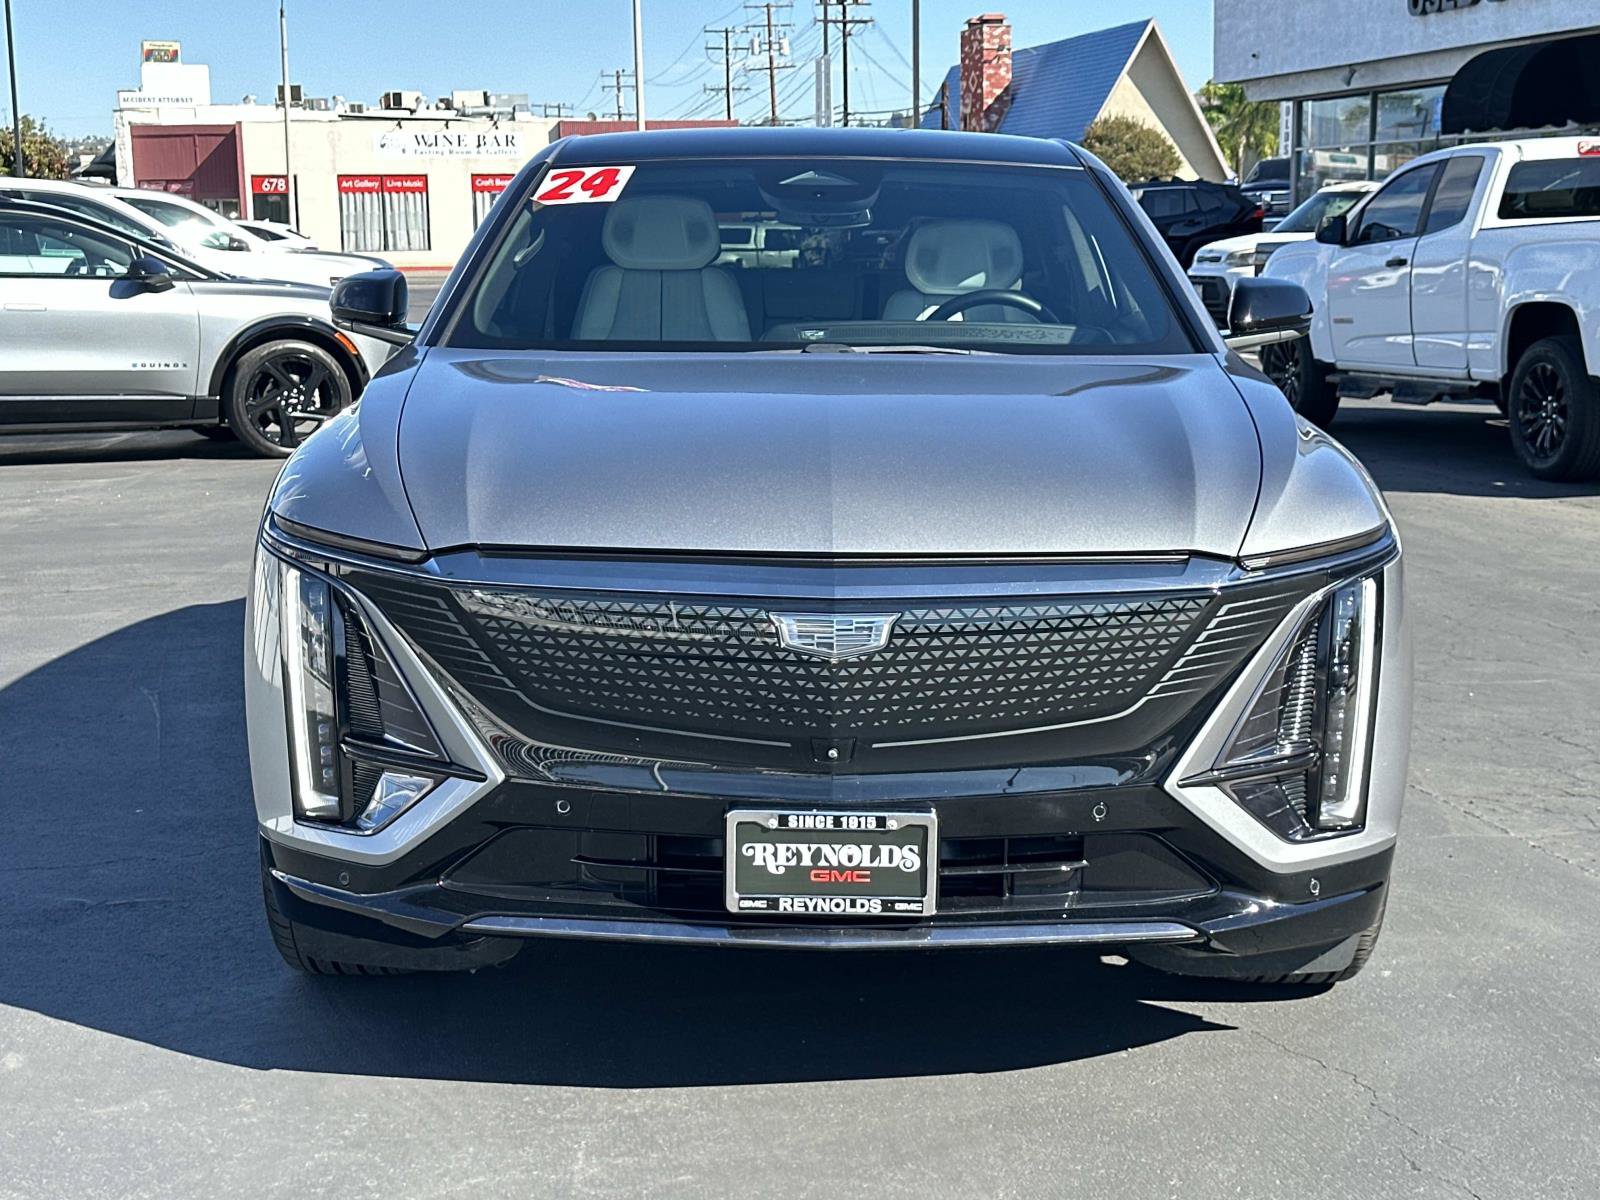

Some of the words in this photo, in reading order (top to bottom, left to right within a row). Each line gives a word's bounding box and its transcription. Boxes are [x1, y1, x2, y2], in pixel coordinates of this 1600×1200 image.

[414, 134, 468, 148] WINE
[476, 134, 516, 148] BAR
[261, 178, 286, 192] 678
[354, 180, 379, 190] Gallery
[537, 168, 621, 201] 24
[788, 815, 834, 829] SINCE
[840, 816, 877, 829] 1915
[742, 842, 921, 874] REYNOLDS
[810, 869, 871, 882] GMC
[739, 899, 767, 908] GMC
[778, 898, 882, 913] REYNOLDS
[894, 902, 923, 911] GMC
